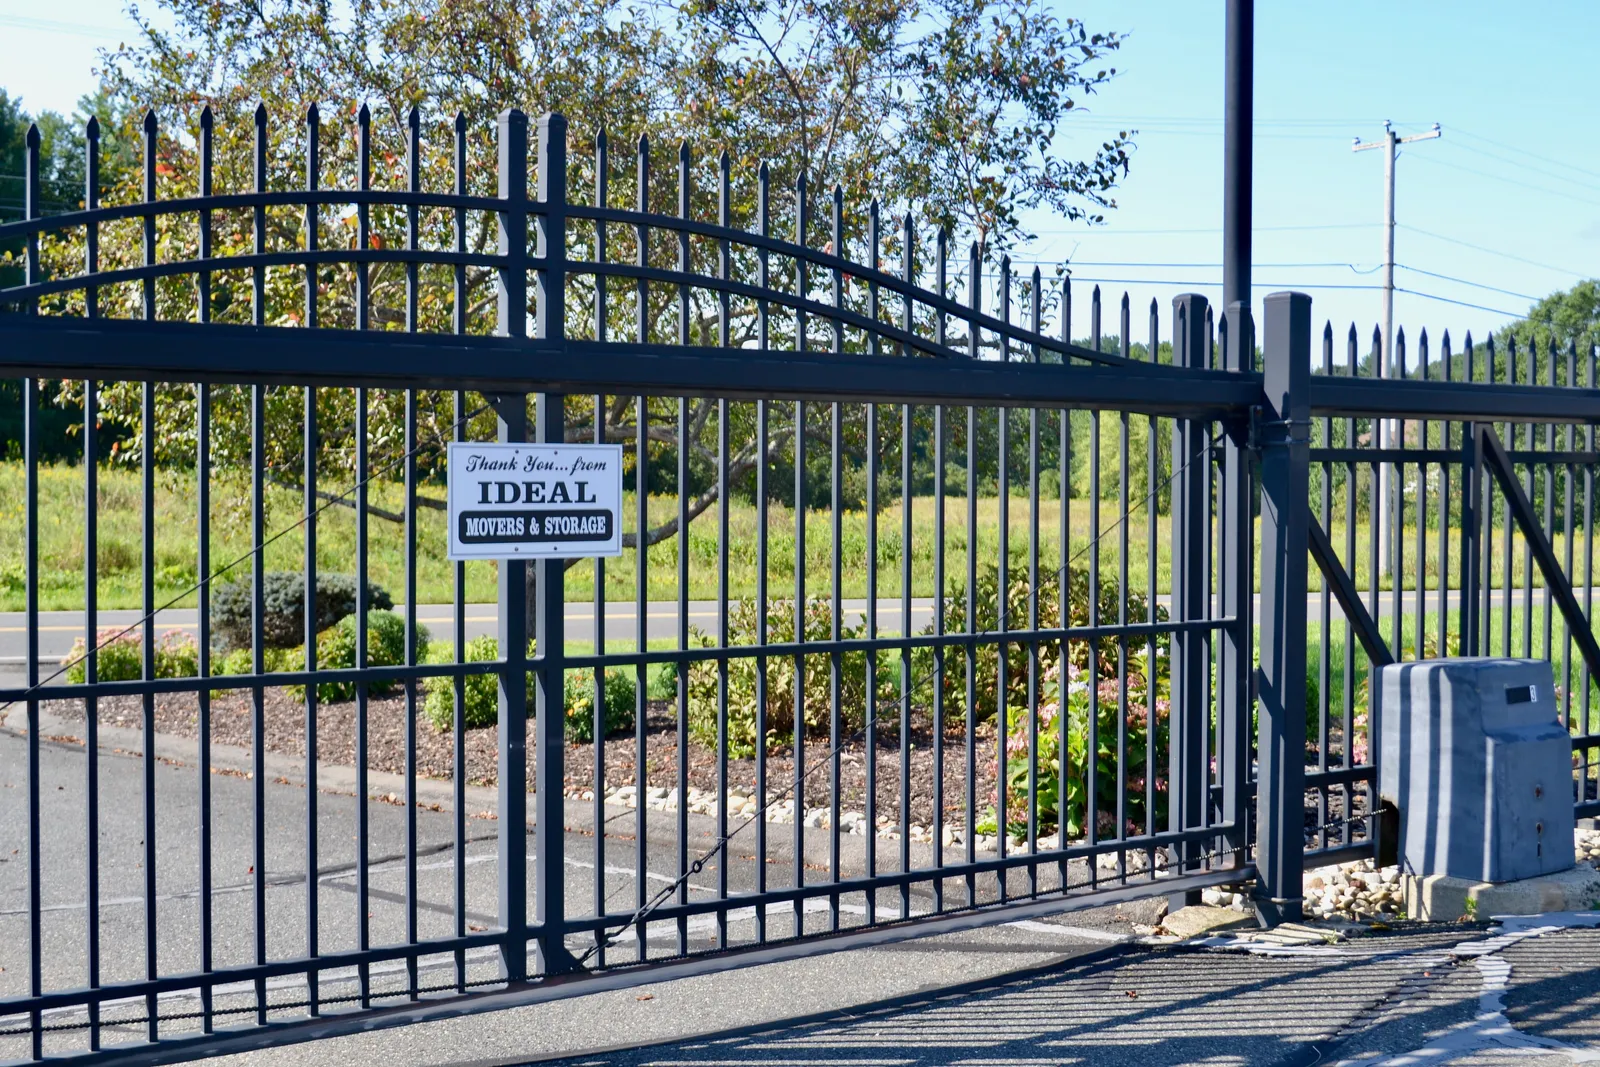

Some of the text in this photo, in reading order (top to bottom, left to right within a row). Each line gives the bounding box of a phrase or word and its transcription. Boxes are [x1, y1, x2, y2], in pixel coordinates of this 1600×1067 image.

[466, 454, 518, 472] Thank
[477, 481, 597, 504] IDEAL
[465, 516, 606, 537] MOVERS & STORAGE
